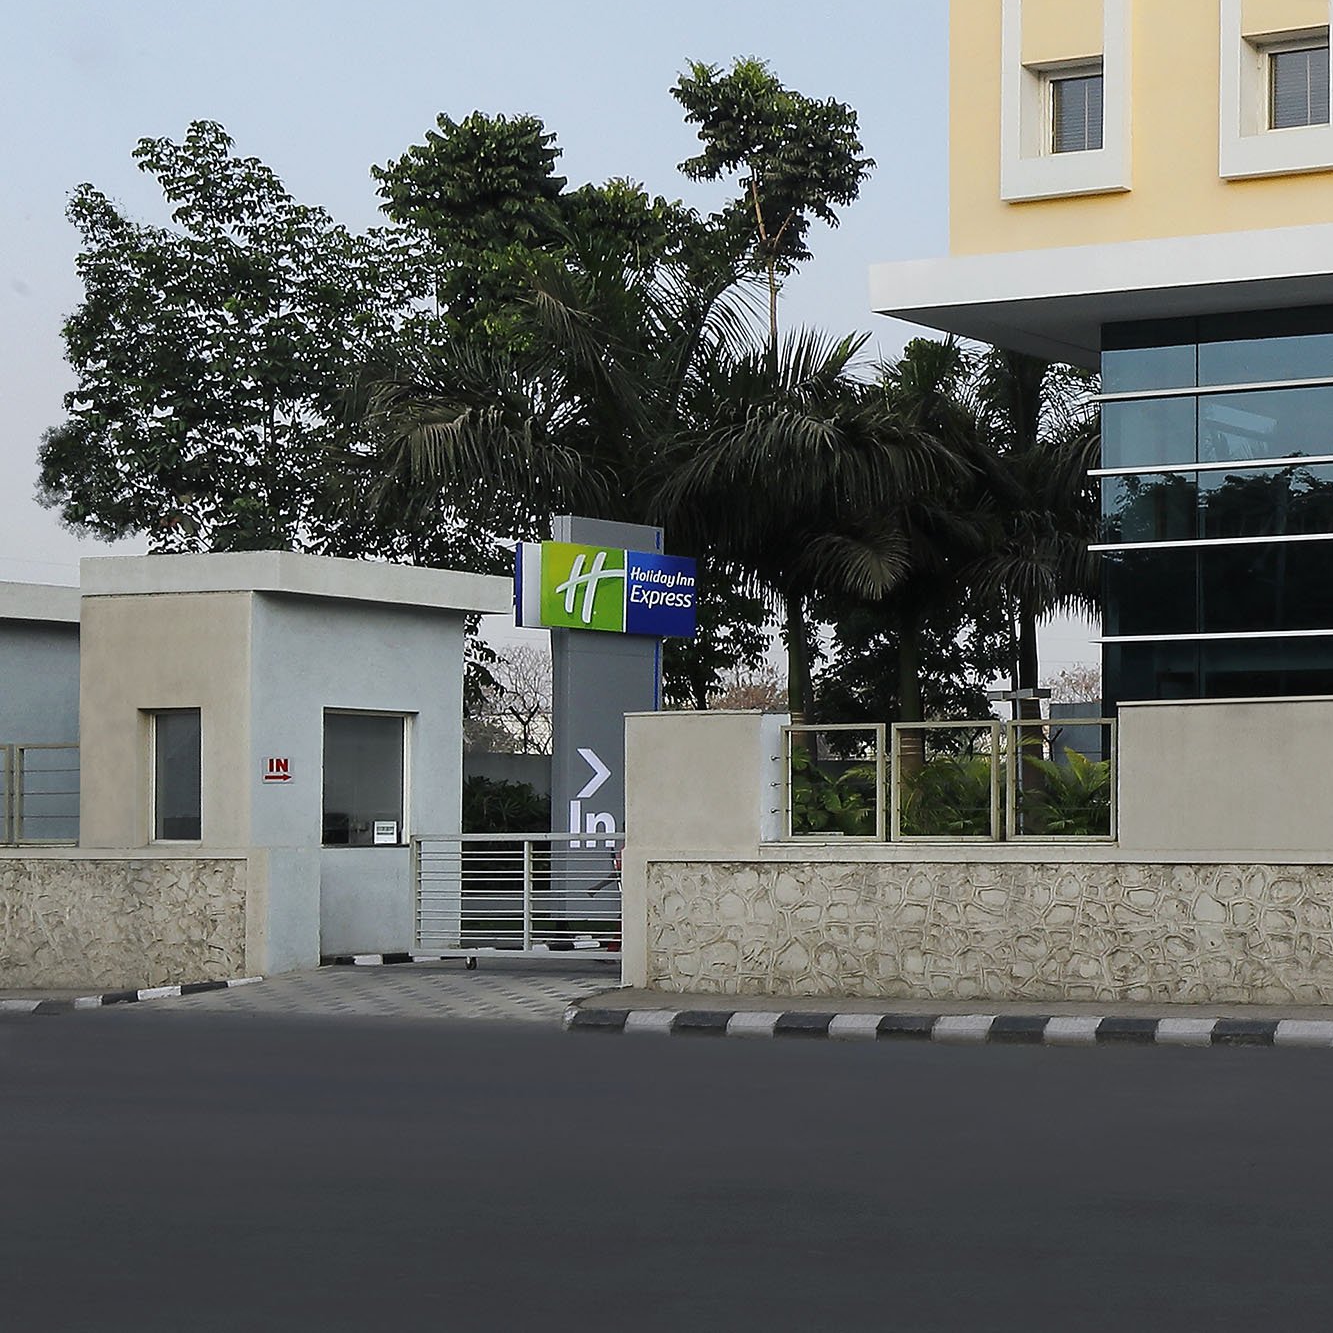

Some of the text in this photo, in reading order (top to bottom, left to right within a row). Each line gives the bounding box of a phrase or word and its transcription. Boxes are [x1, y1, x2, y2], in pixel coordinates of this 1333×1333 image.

[630, 566, 695, 588] Holiday Inn
[630, 584, 693, 609] Express
[269, 758, 289, 773] IN
[569, 800, 616, 848] In
